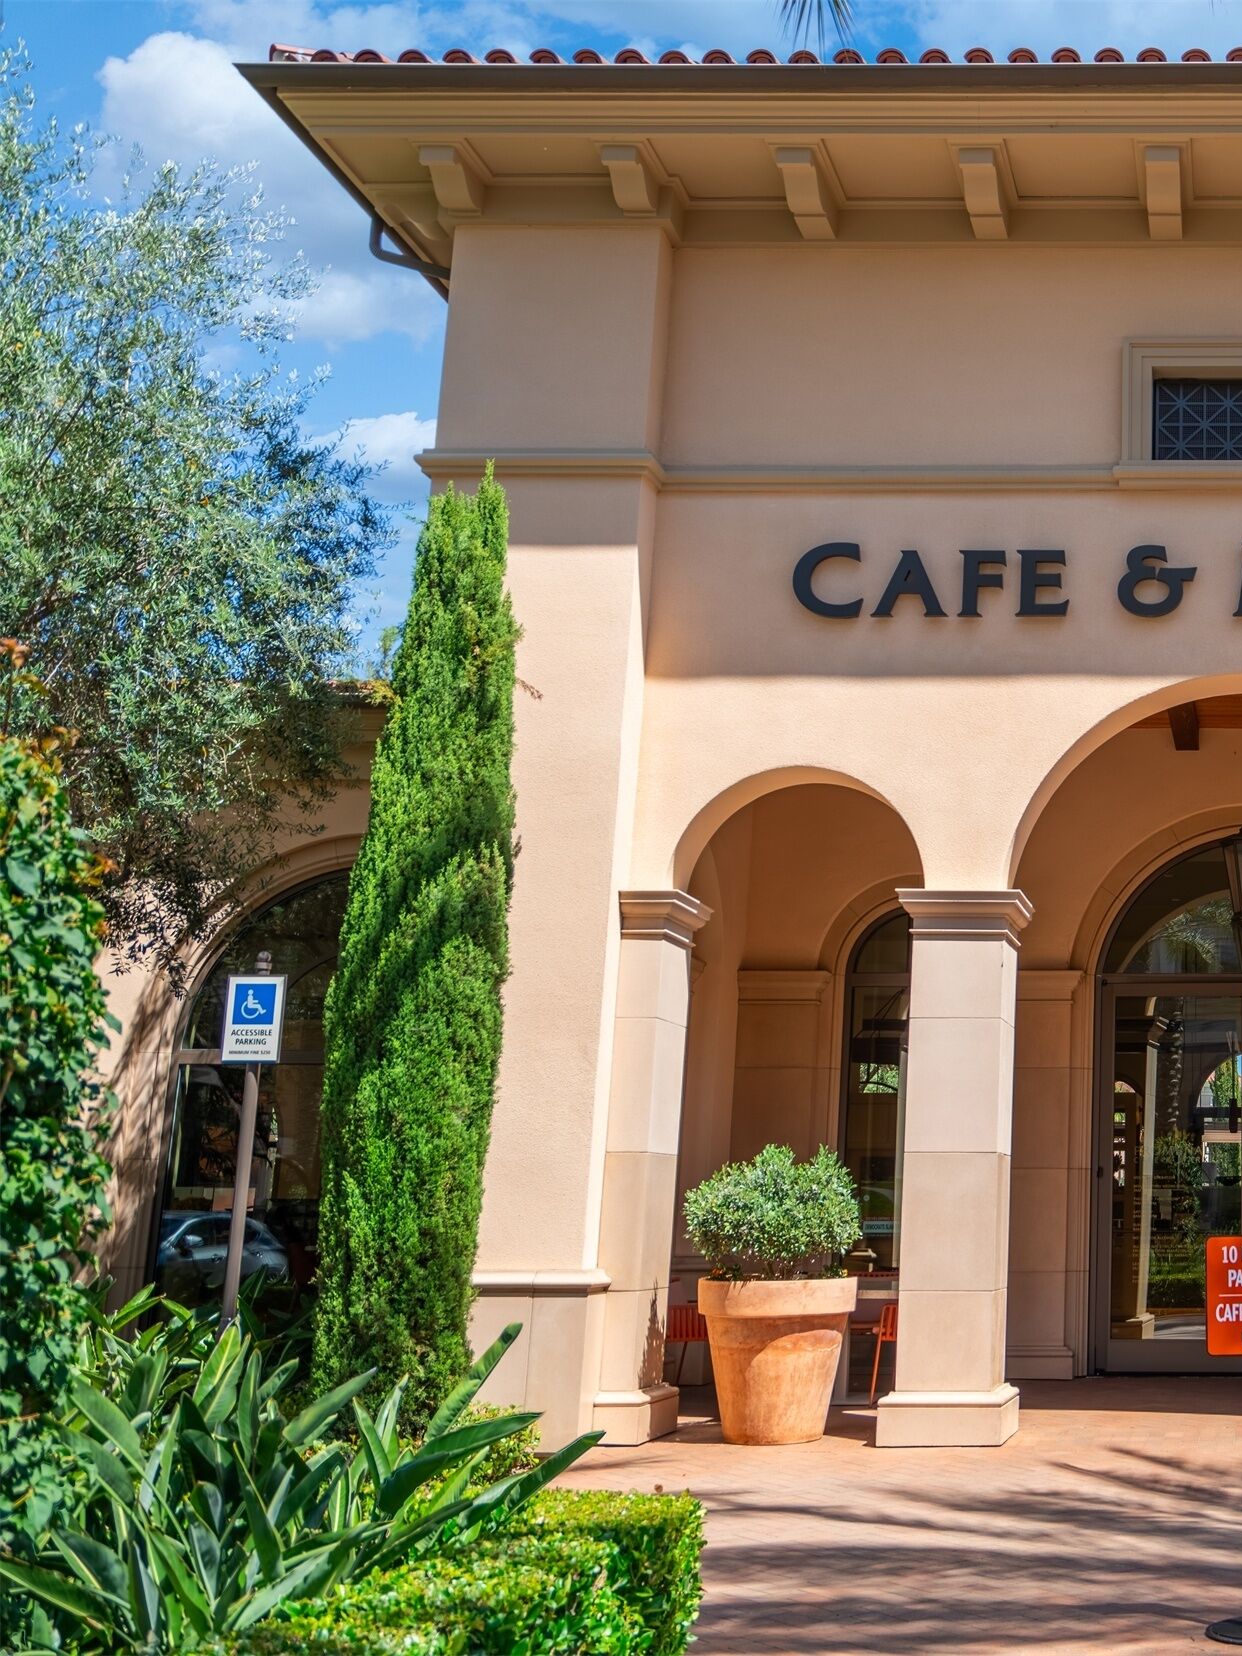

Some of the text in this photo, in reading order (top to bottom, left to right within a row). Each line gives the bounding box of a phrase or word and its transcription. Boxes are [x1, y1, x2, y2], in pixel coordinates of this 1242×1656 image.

[793, 541, 1070, 619] CAFE
[1117, 544, 1198, 618] &
[231, 1029, 273, 1037] ACCESSIBLE
[235, 1038, 267, 1046] PARKING
[1221, 1245, 1238, 1264] 10
